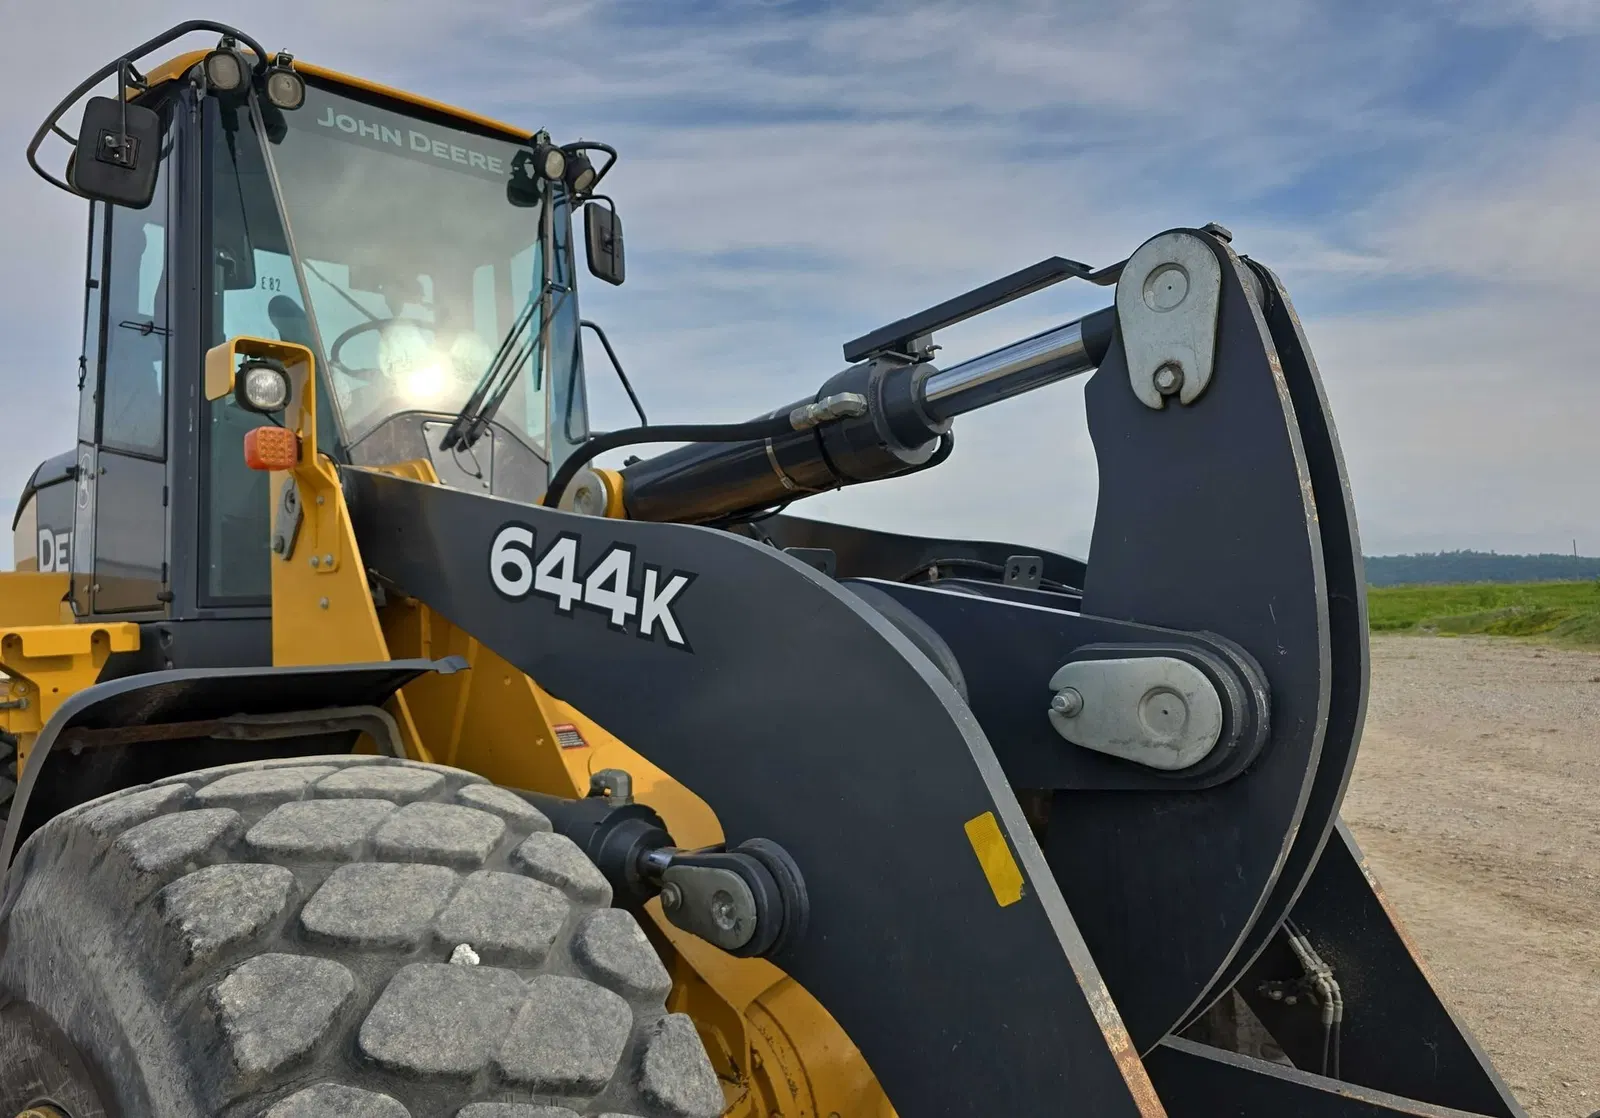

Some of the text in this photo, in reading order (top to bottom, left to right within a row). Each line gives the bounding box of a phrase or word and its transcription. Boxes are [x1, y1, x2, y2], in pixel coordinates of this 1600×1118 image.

[317, 107, 504, 175] JOHN DEERE
[39, 528, 74, 572] DE
[490, 526, 689, 645] 644K
